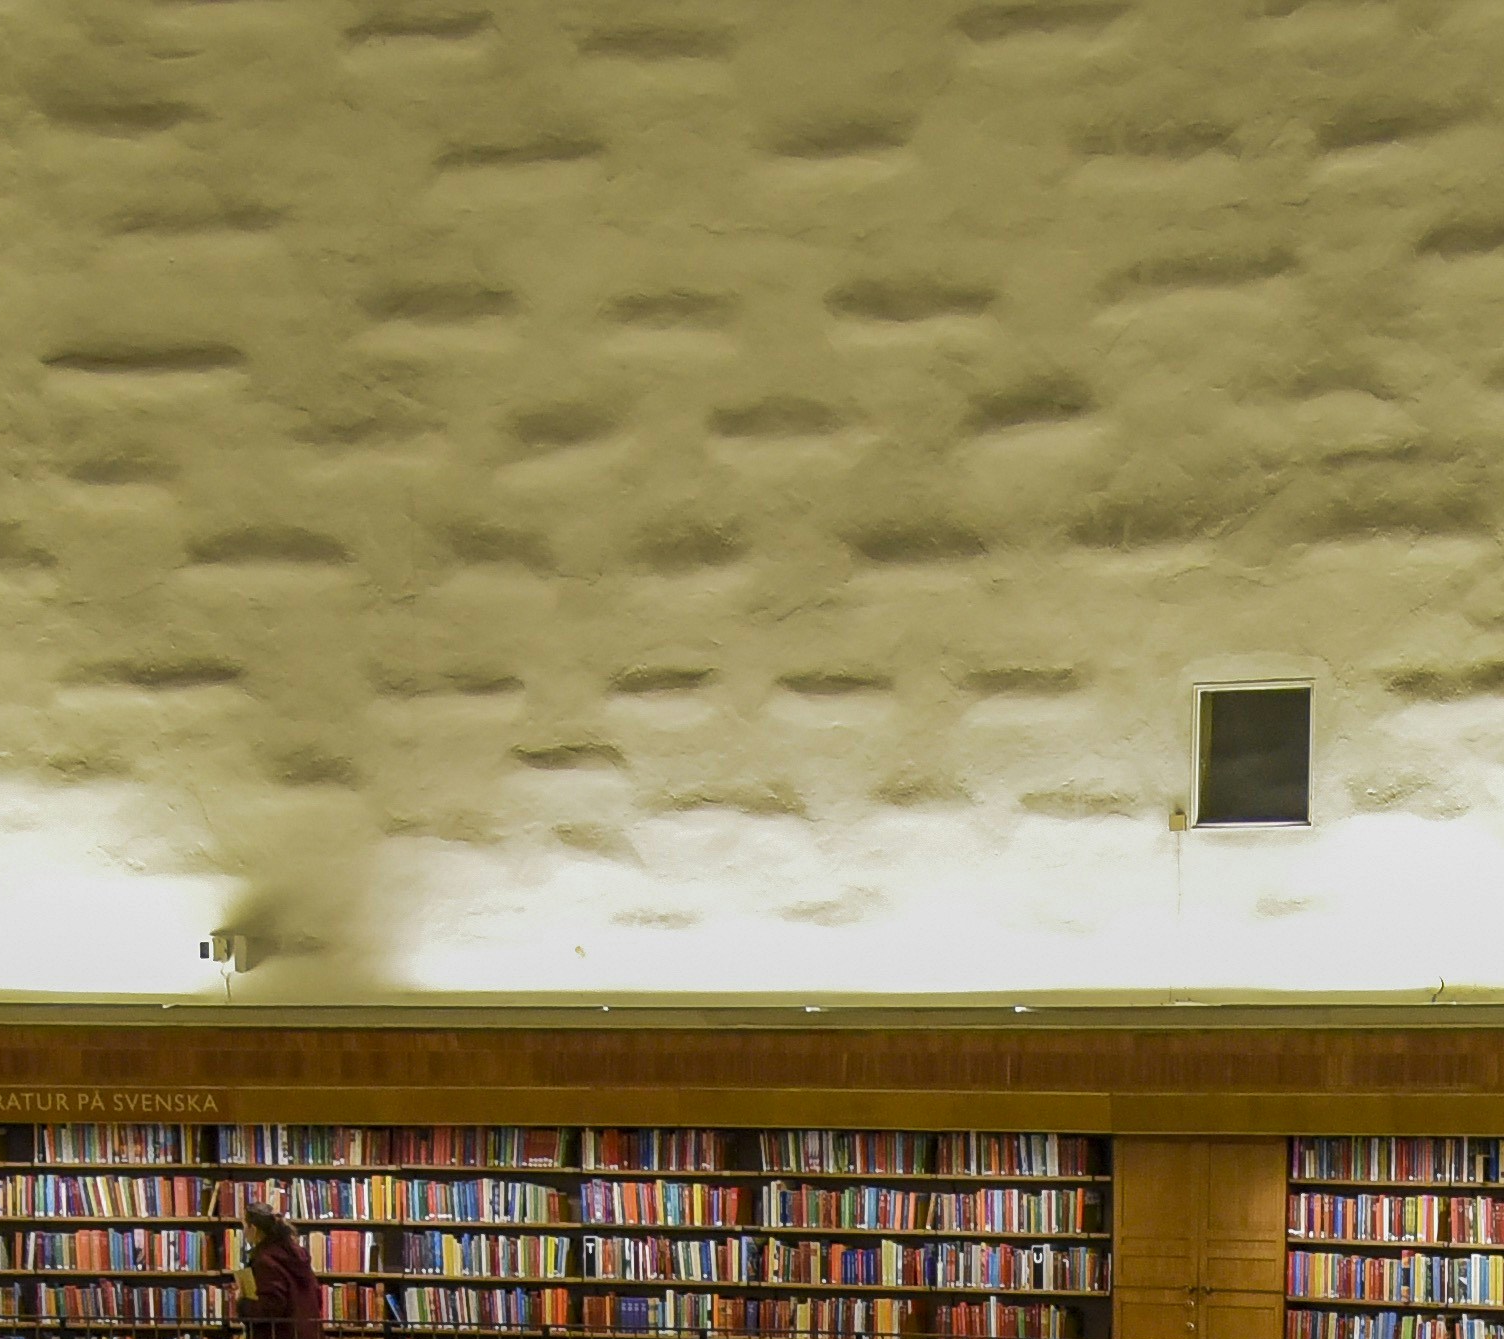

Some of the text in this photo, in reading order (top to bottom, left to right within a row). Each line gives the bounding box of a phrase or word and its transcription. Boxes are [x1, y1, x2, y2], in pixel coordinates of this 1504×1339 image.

[78, 1090, 105, 1111] PÅ
[113, 1093, 219, 1112] SVENSKA
[586, 1243, 596, 1254] T
[1033, 1252, 1043, 1264] U
